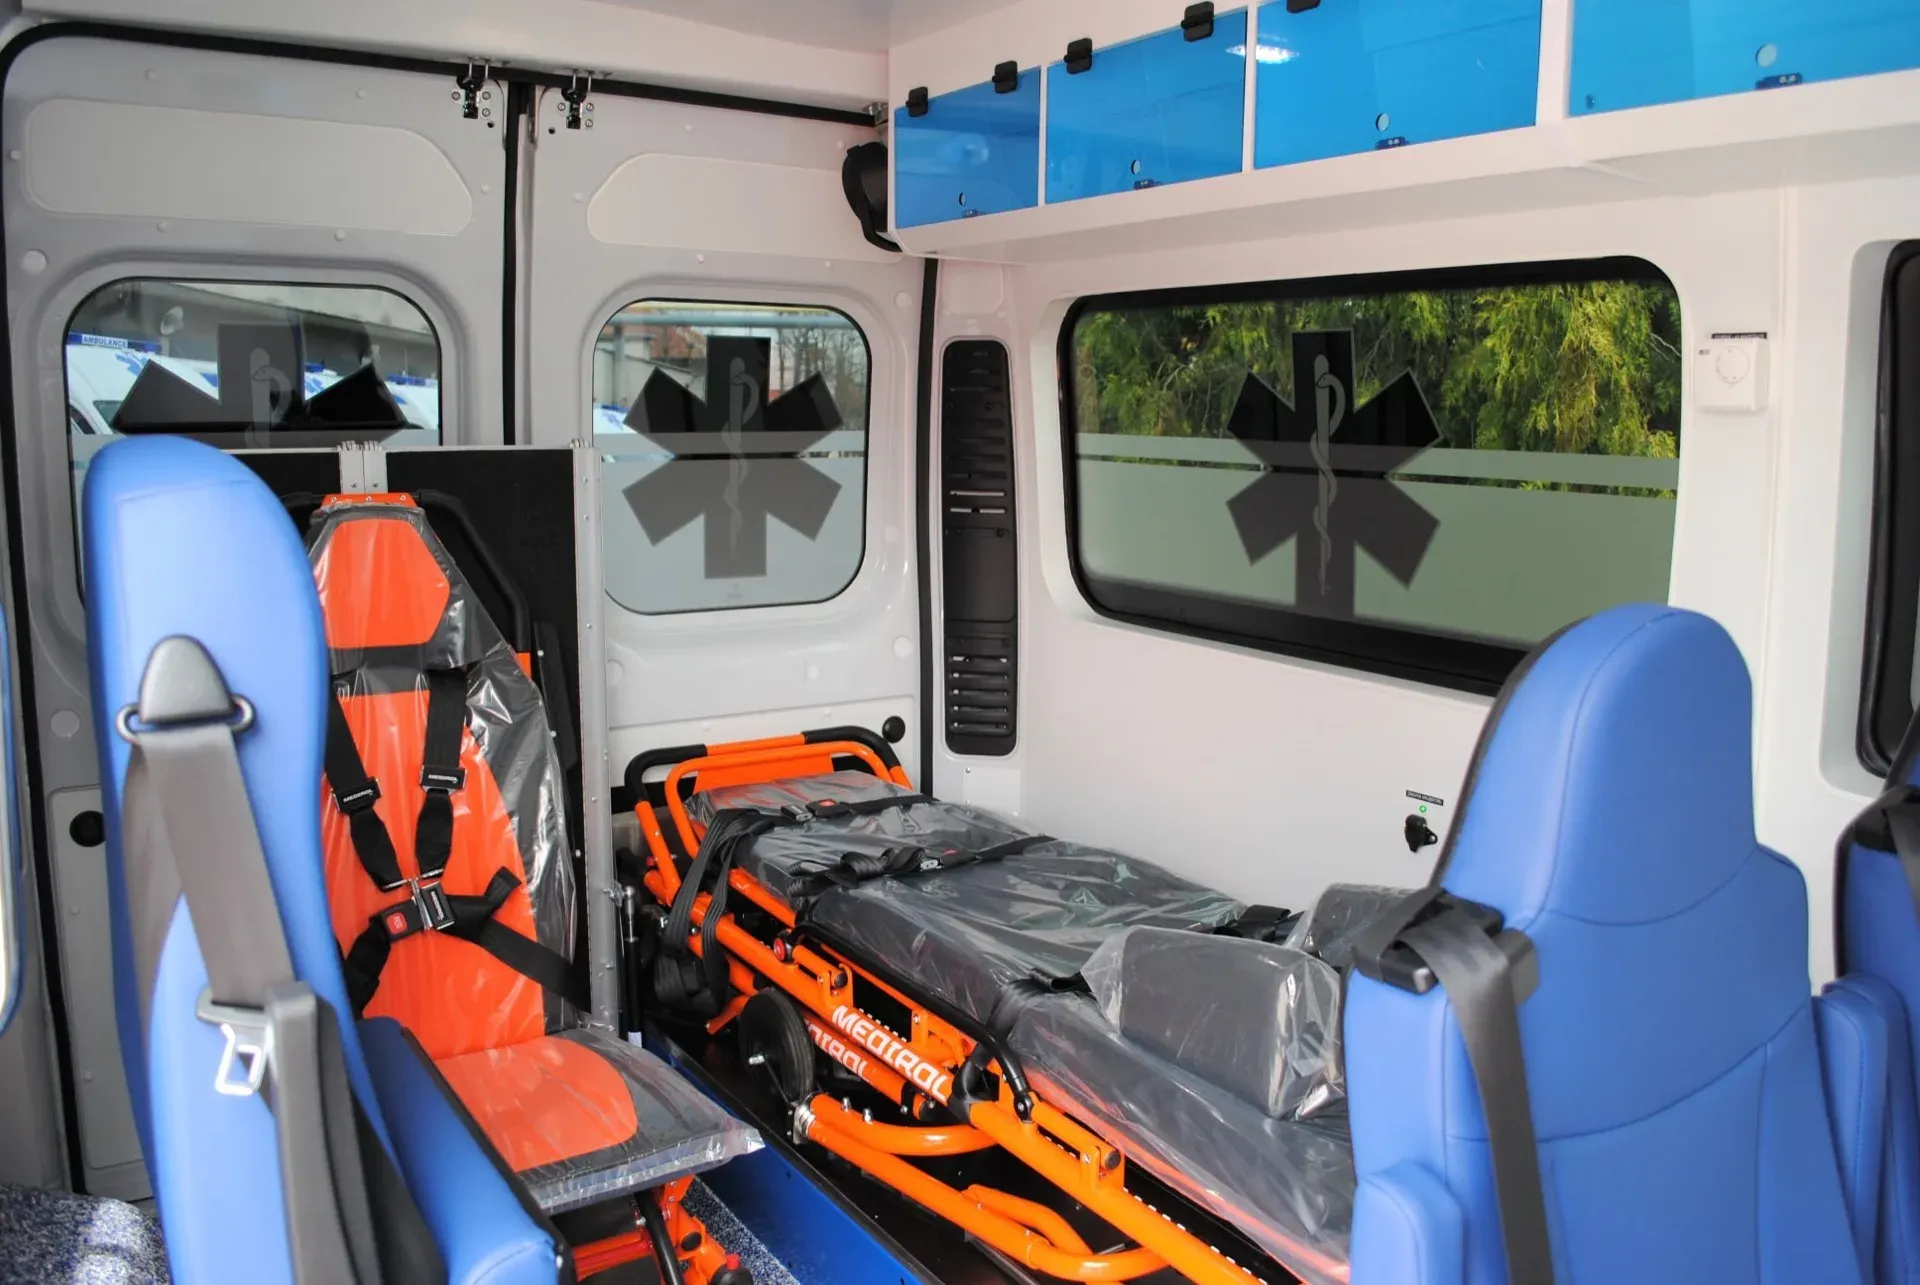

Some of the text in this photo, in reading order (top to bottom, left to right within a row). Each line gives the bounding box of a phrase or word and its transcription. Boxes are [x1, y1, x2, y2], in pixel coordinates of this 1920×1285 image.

[83, 335, 126, 348] AMBULANCE
[343, 789, 374, 802] MEDIROL
[804, 1018, 871, 1083] DIROL
[832, 1004, 948, 1107] MEDIROL
